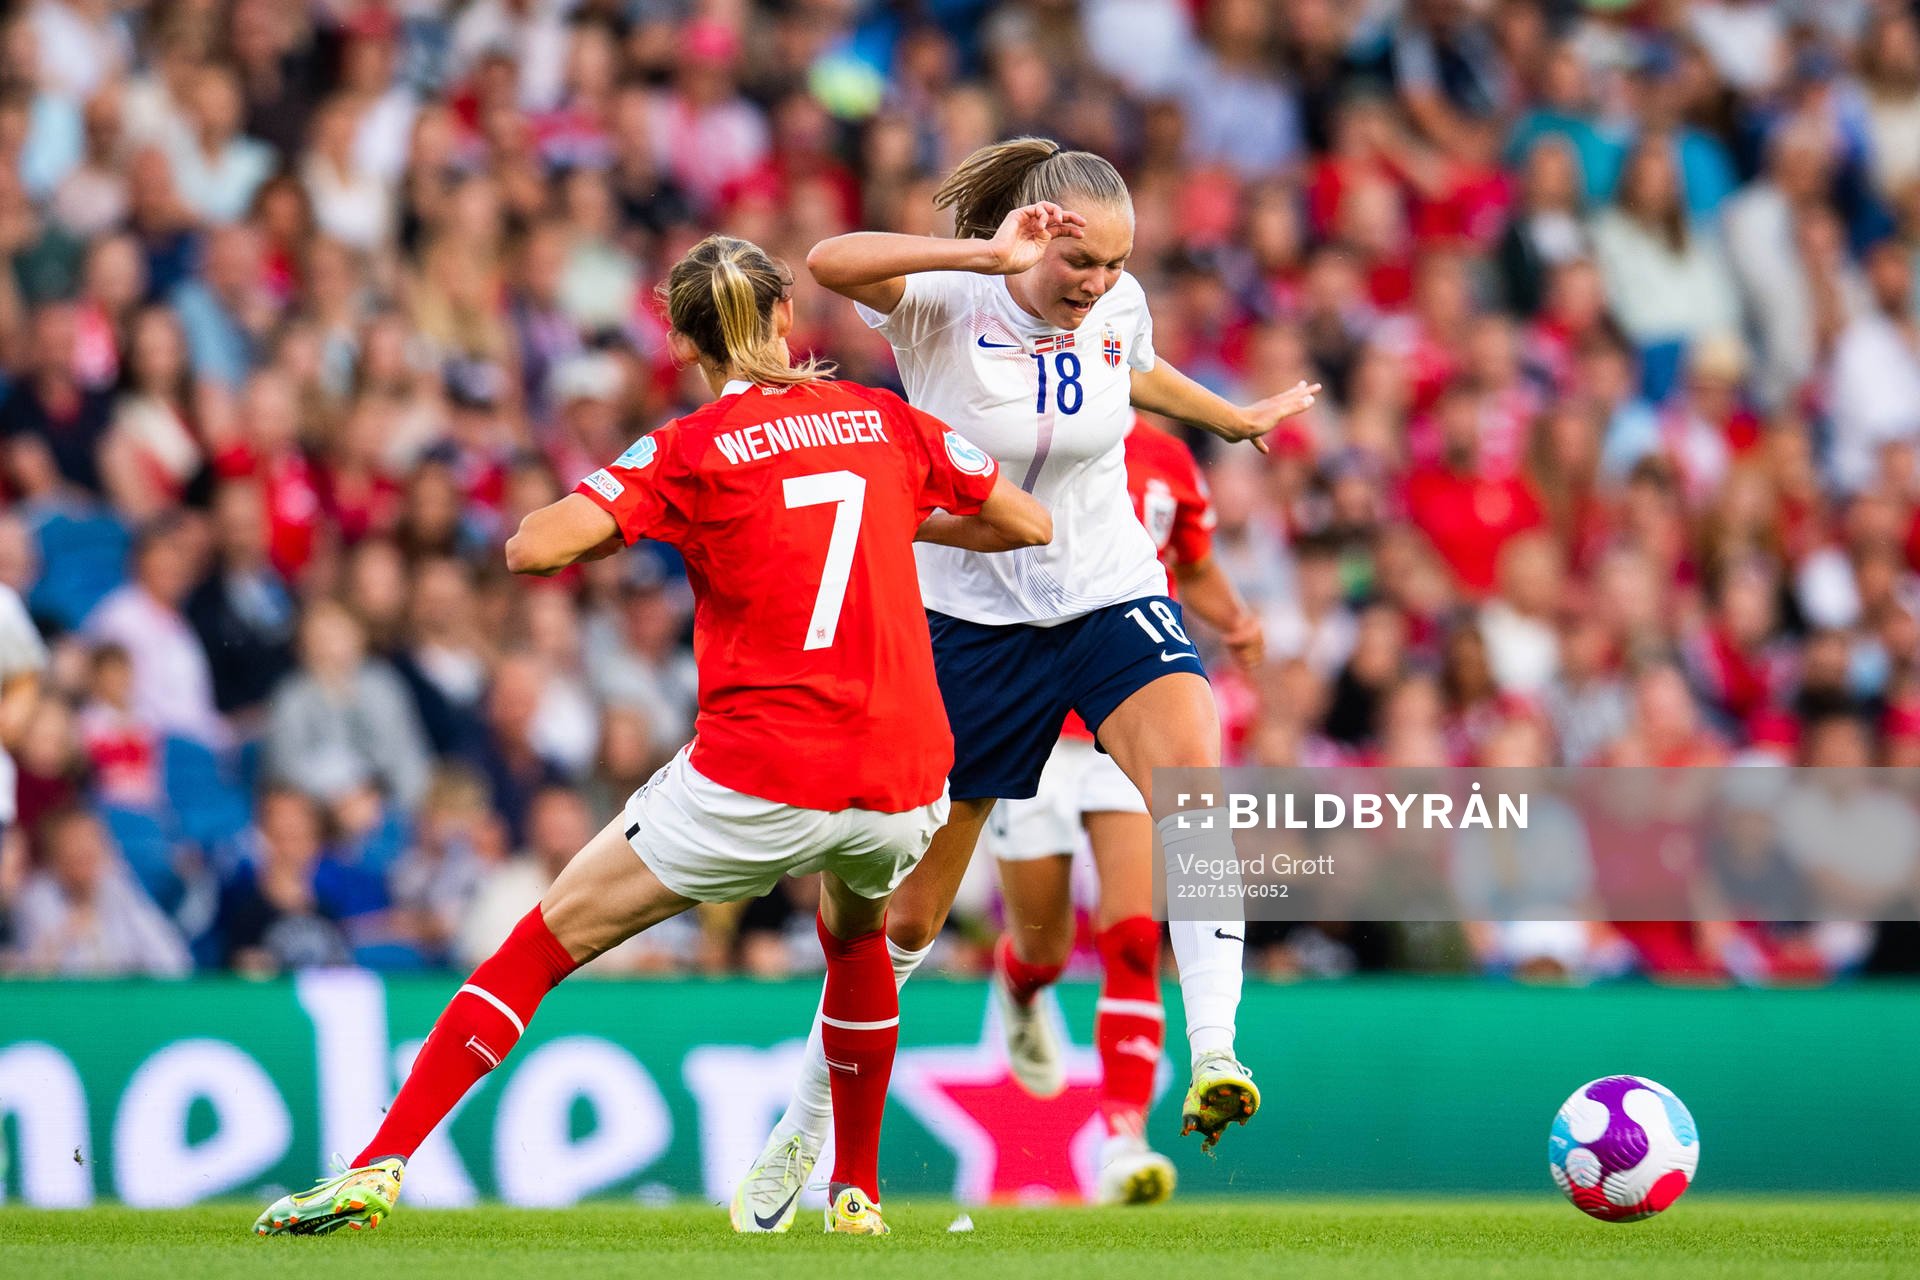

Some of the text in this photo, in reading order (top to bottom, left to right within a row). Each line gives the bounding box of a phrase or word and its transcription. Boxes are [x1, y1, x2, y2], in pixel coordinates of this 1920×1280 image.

[1030, 352, 1083, 415] 18
[714, 410, 888, 465] WENNINGER
[782, 470, 866, 651] 7
[1125, 601, 1191, 646] 18
